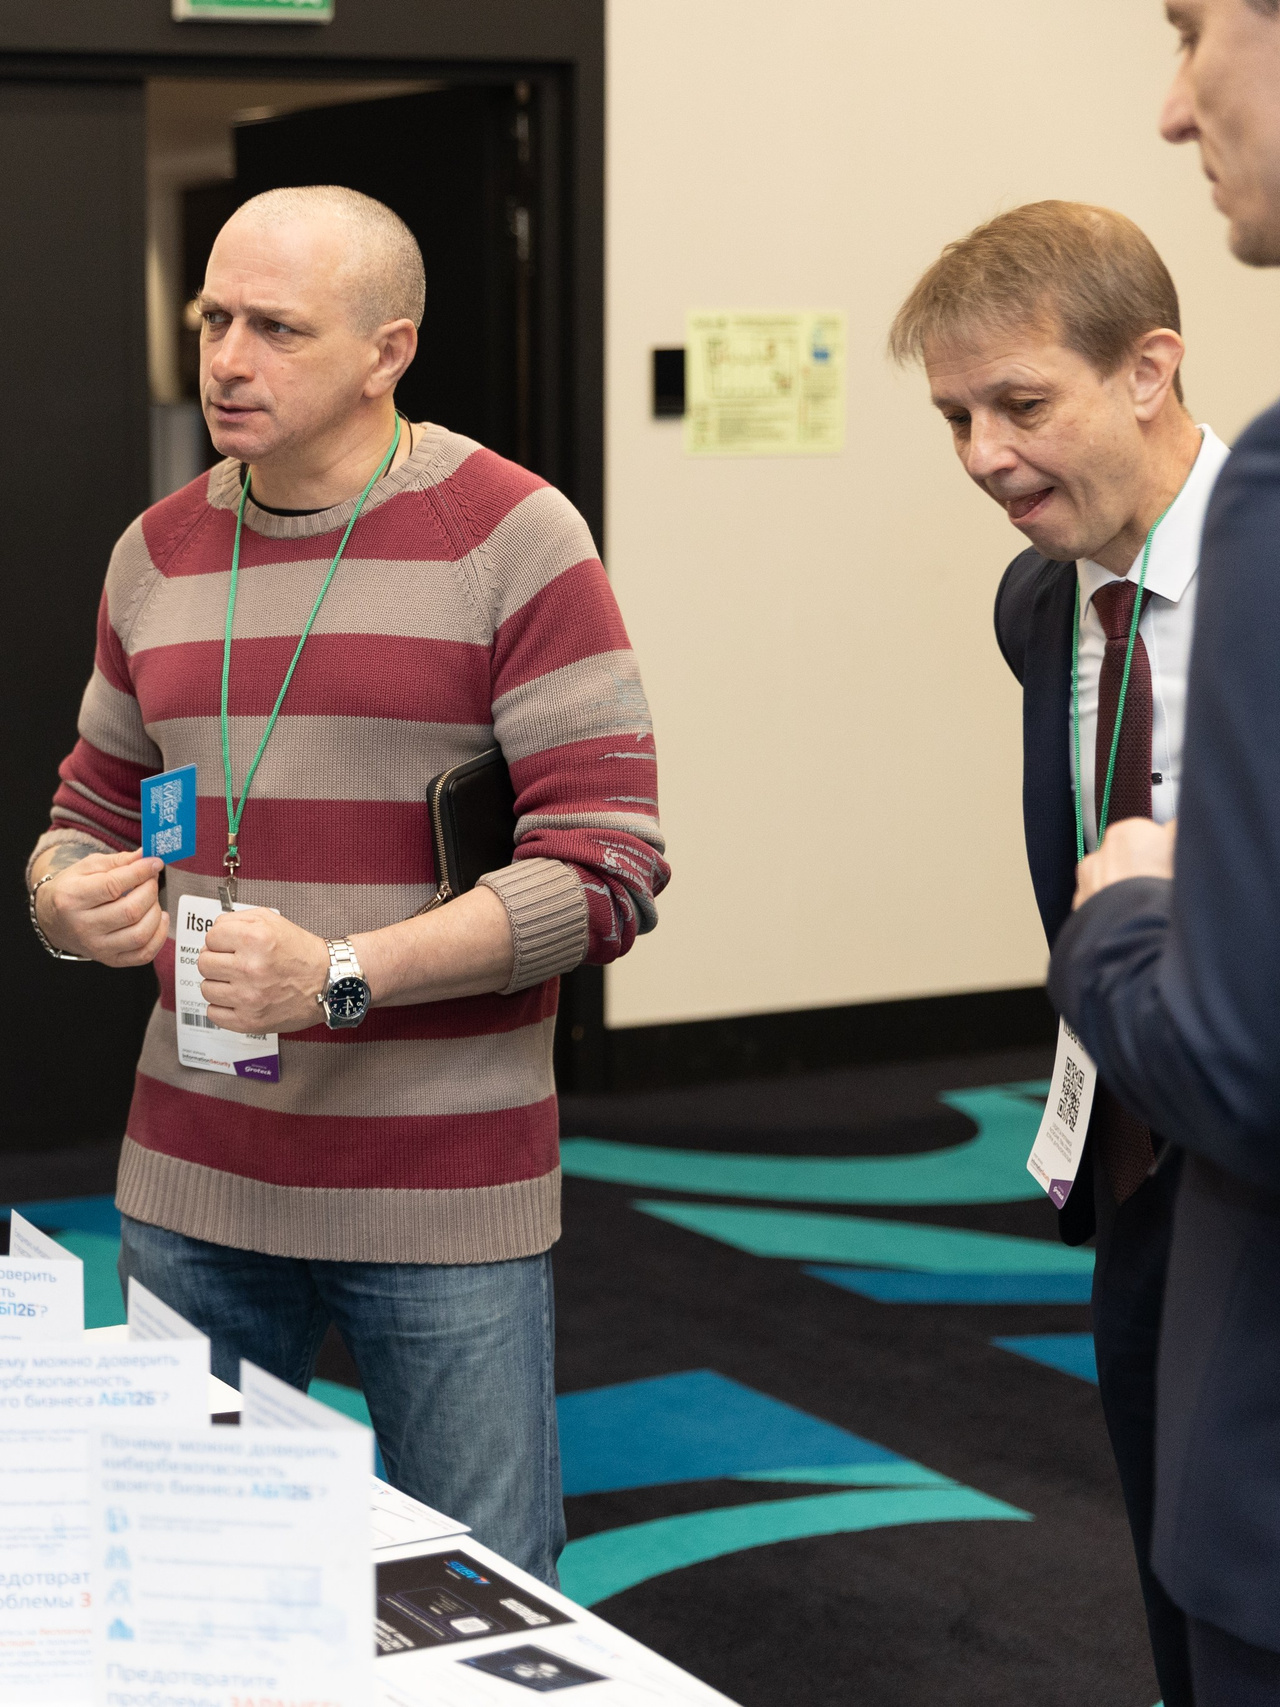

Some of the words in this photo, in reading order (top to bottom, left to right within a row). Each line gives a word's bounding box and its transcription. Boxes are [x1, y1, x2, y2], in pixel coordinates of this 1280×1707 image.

[163, 781, 174, 823] КИБЕР
[180, 946, 200, 954] МИХА
[32, 1355, 93, 1369] можно
[23, 1393, 94, 1408] бизнеса
